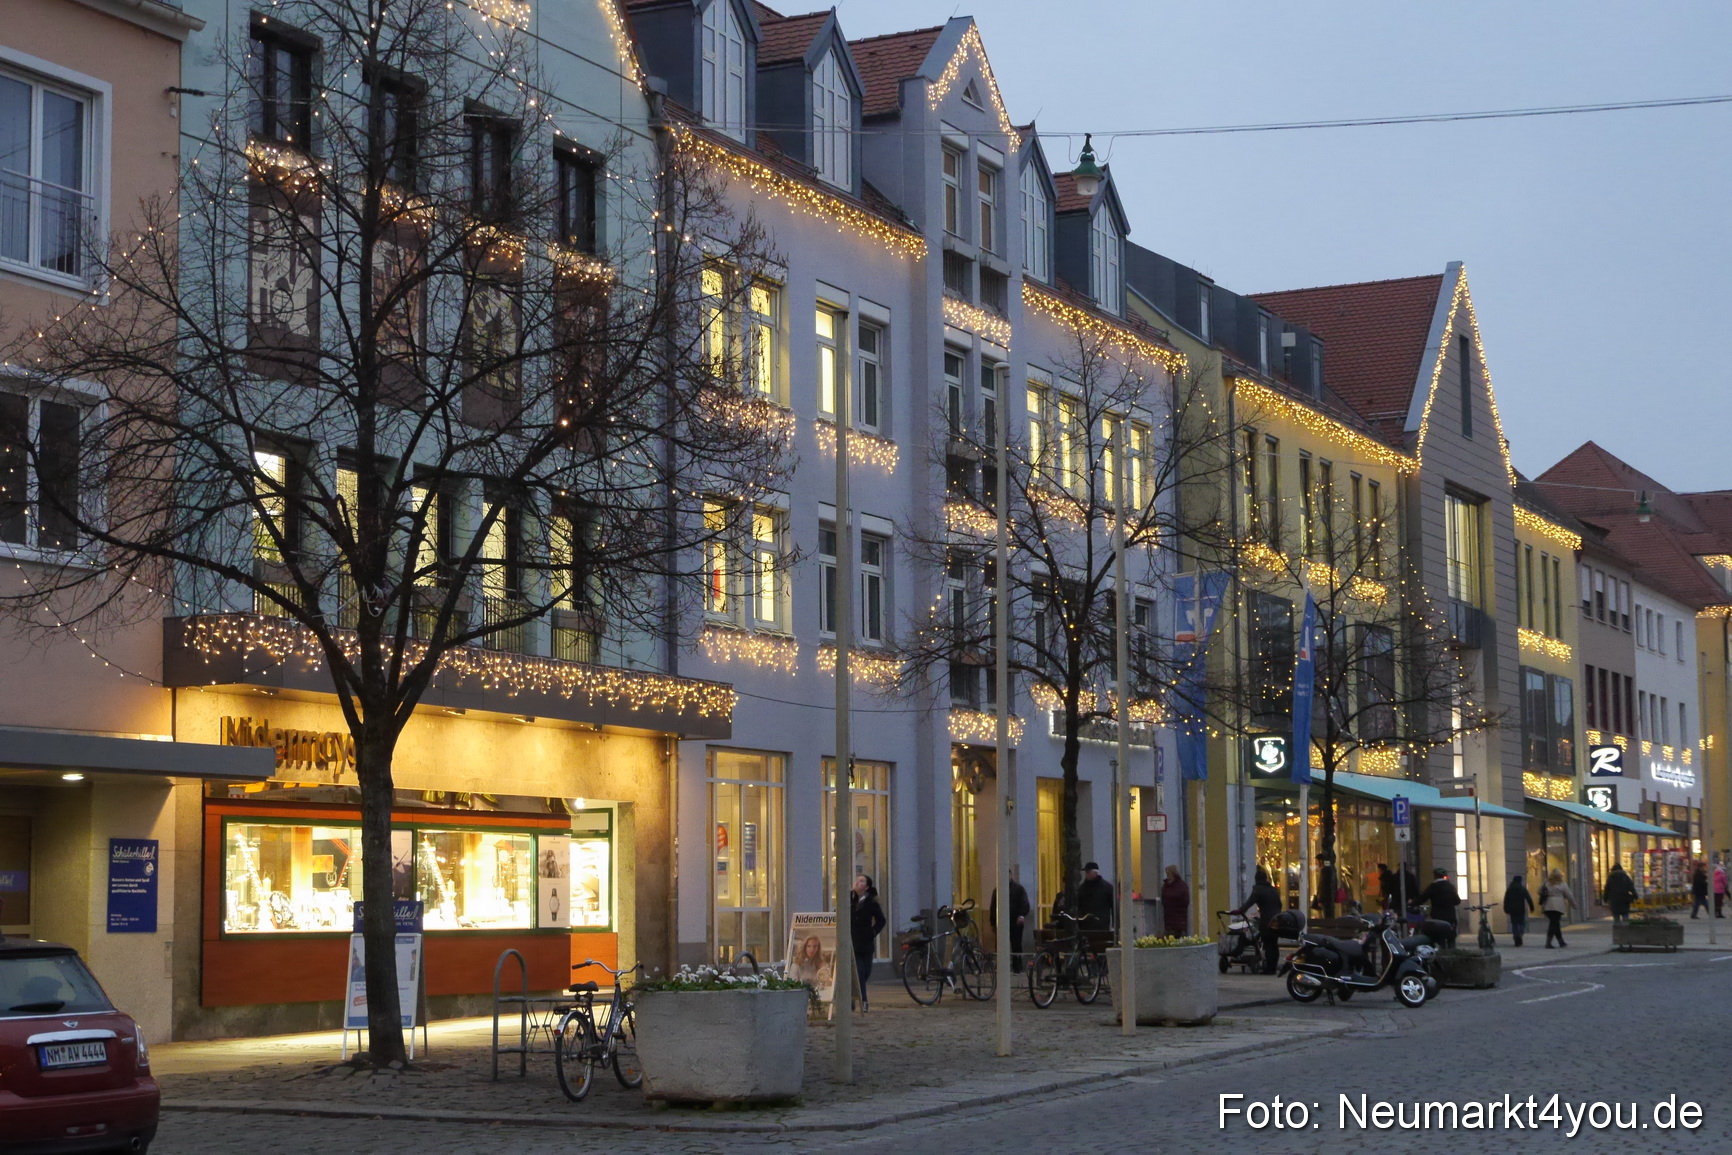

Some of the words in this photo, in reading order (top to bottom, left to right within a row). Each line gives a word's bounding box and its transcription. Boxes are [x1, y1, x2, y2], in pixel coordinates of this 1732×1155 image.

[1396, 801, 1406, 821] P
[46, 1047, 60, 1063] NM
[68, 1046, 80, 1061] AW
[82, 1044, 105, 1060] 4444
